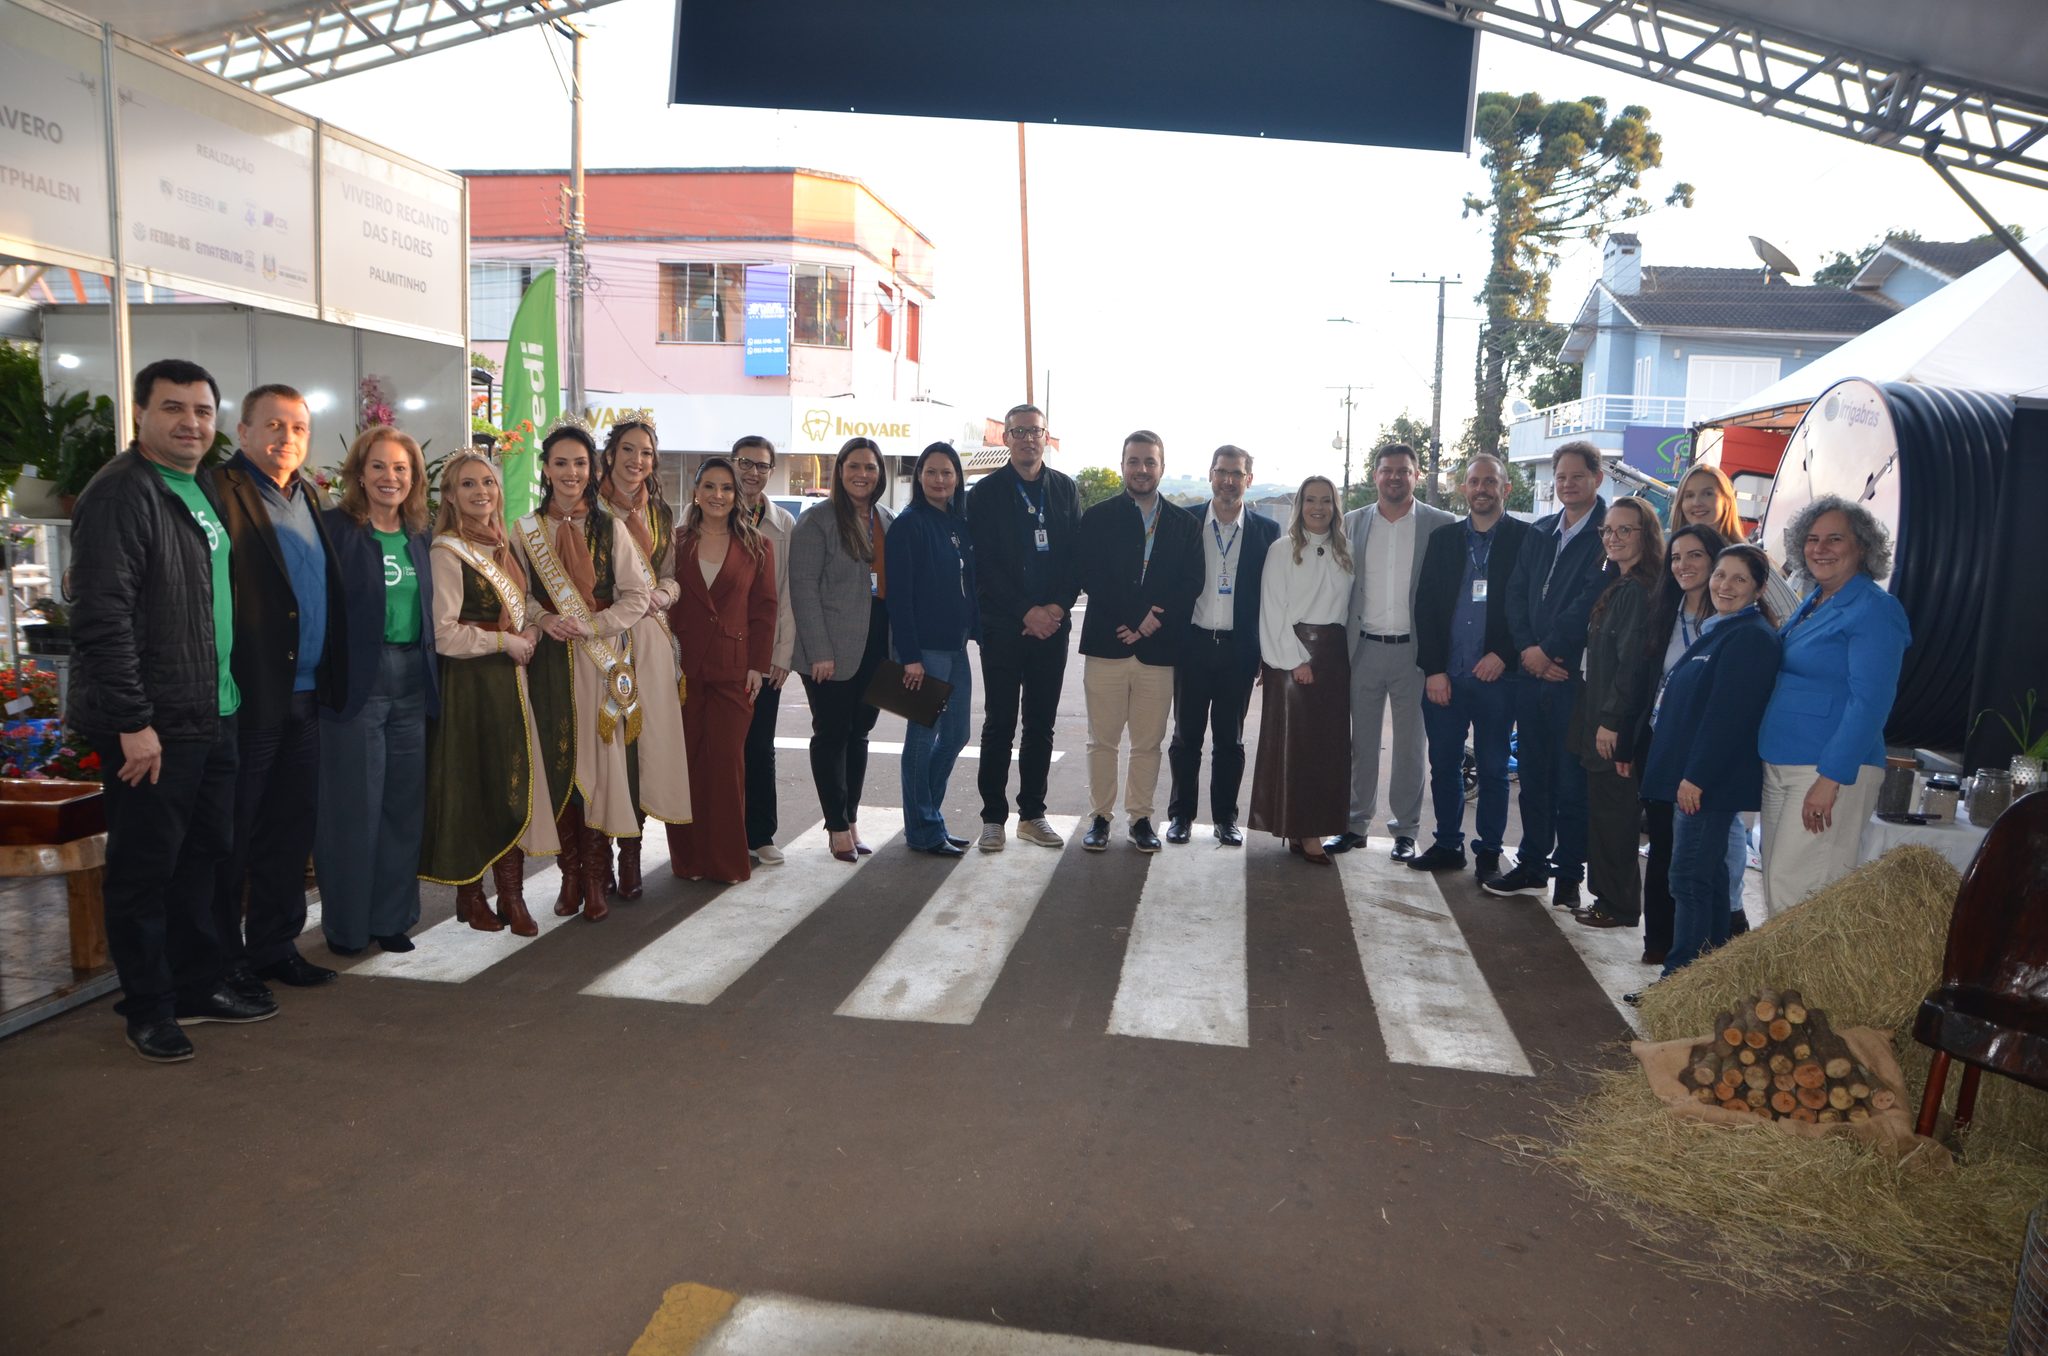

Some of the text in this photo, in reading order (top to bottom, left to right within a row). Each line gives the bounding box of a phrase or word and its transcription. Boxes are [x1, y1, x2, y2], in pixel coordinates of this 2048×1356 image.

[196, 143, 255, 174] REALIZAÇÃO
[176, 188, 214, 210] SEBERI
[341, 181, 449, 236] VIVEIRO RECANTO
[362, 220, 433, 258] DAS FLORES
[369, 265, 427, 294] PALMITINHO
[1839, 398, 1879, 428] Irrigabras
[526, 529, 565, 597] RAINHA
